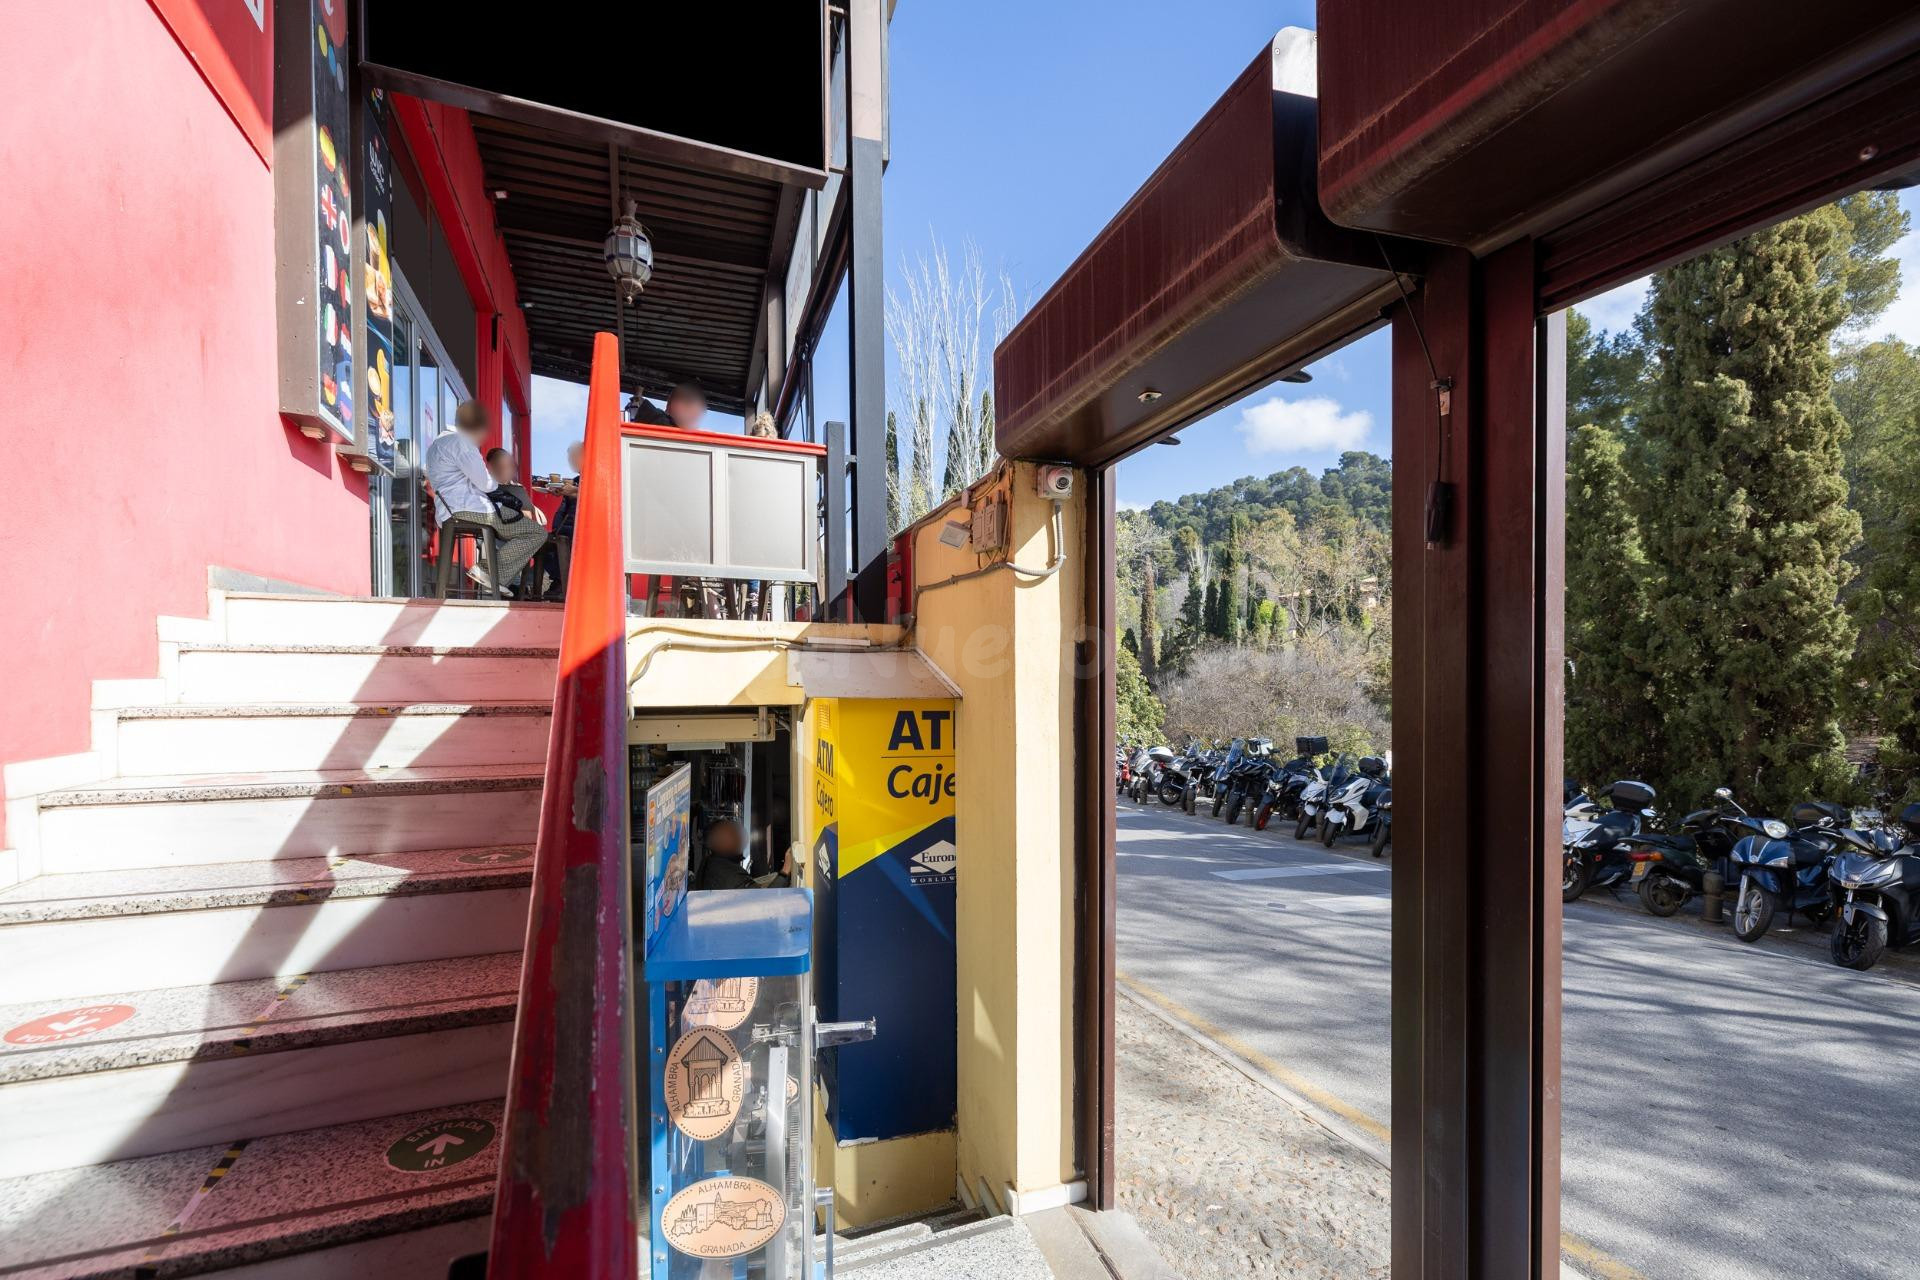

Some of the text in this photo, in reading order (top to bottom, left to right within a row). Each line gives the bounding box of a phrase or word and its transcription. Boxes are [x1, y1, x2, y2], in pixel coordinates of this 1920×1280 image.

[816, 738, 834, 778] ATM
[816, 779, 834, 817] Cajero
[921, 852, 956, 863] Euron
[671, 1061, 681, 1113] ALHAMBRA
[731, 1056, 742, 1102] GRANADA
[405, 1121, 486, 1143] ENTRADA
[423, 1156, 446, 1169] IN
[697, 1180, 752, 1194] ALHAMBRA
[699, 1242, 747, 1255] GRANADA
